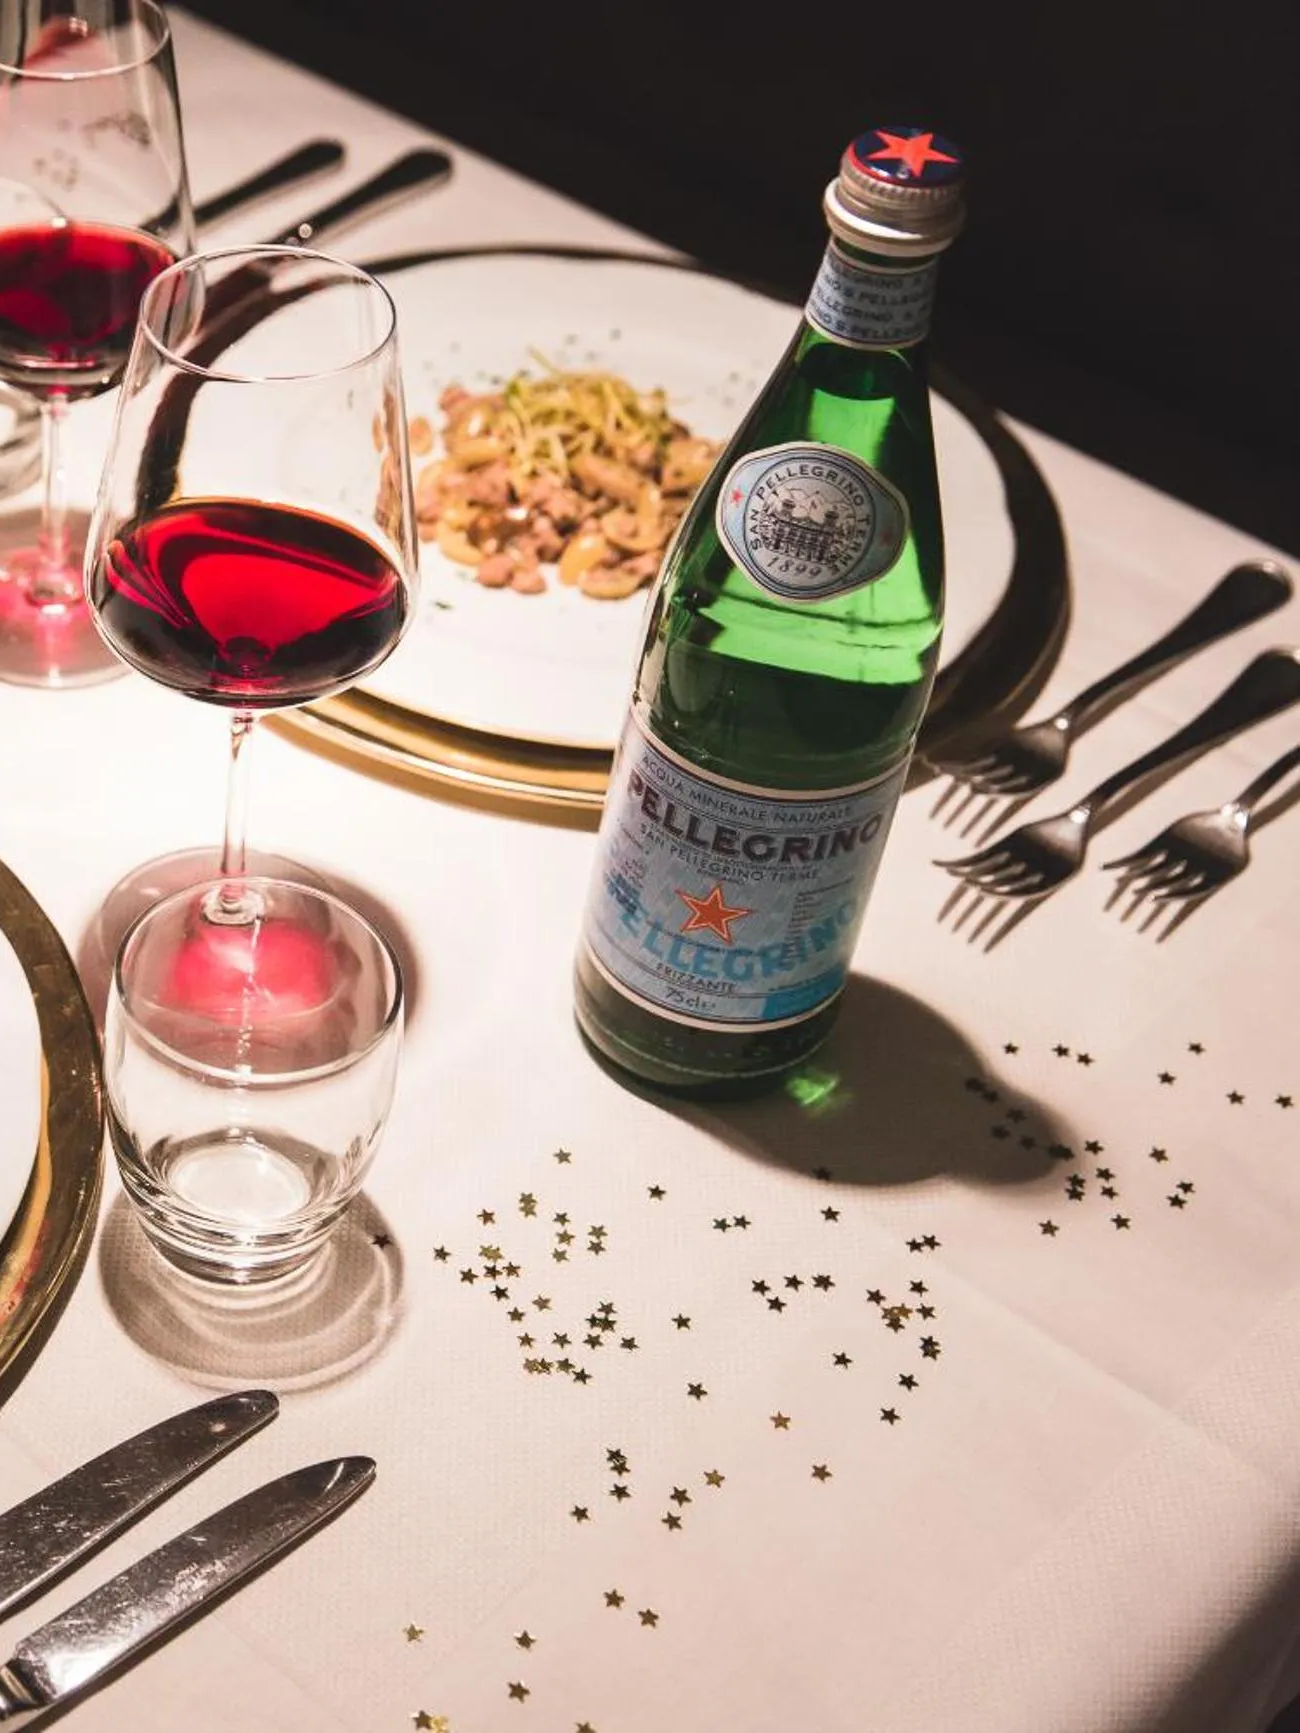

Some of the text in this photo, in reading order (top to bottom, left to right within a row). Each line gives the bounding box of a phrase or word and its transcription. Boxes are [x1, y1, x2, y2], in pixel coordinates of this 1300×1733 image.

[750, 509, 762, 551] SAN
[756, 463, 865, 507] PELLEGRINO
[767, 556, 822, 577] 1899
[627, 768, 884, 864] PELLEGRINO
[642, 756, 685, 794] ACQUA
[689, 790, 767, 820] MINERALE
[670, 844, 765, 881] PELLEGRINO
